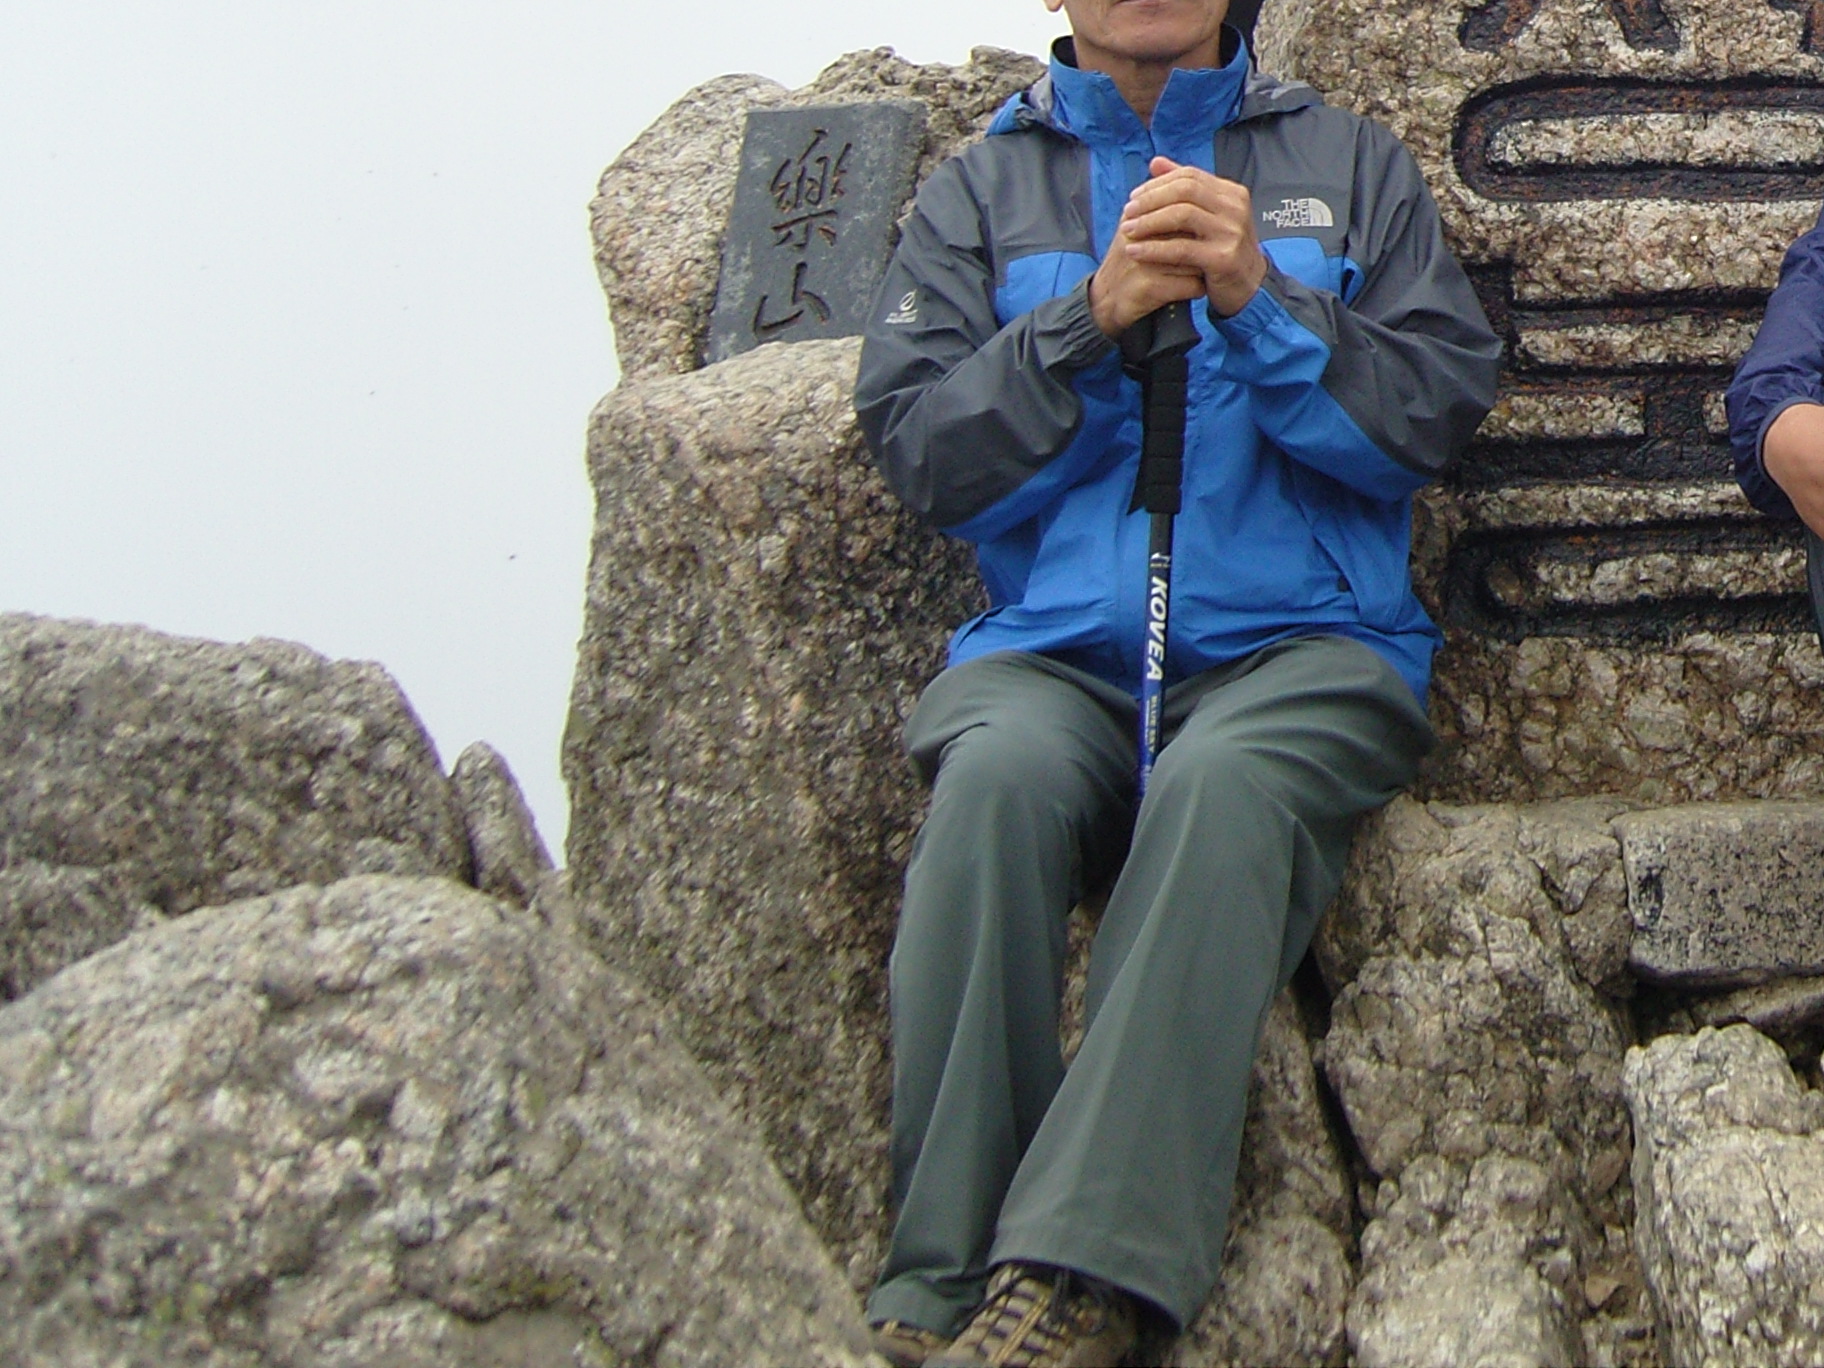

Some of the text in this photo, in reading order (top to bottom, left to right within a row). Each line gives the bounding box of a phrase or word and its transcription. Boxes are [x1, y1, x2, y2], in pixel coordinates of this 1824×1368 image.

[1281, 198, 1309, 211] THE
[1262, 209, 1309, 222] NORTH
[1276, 218, 1310, 229] FACE
[1146, 576, 1168, 680] KOVEA
